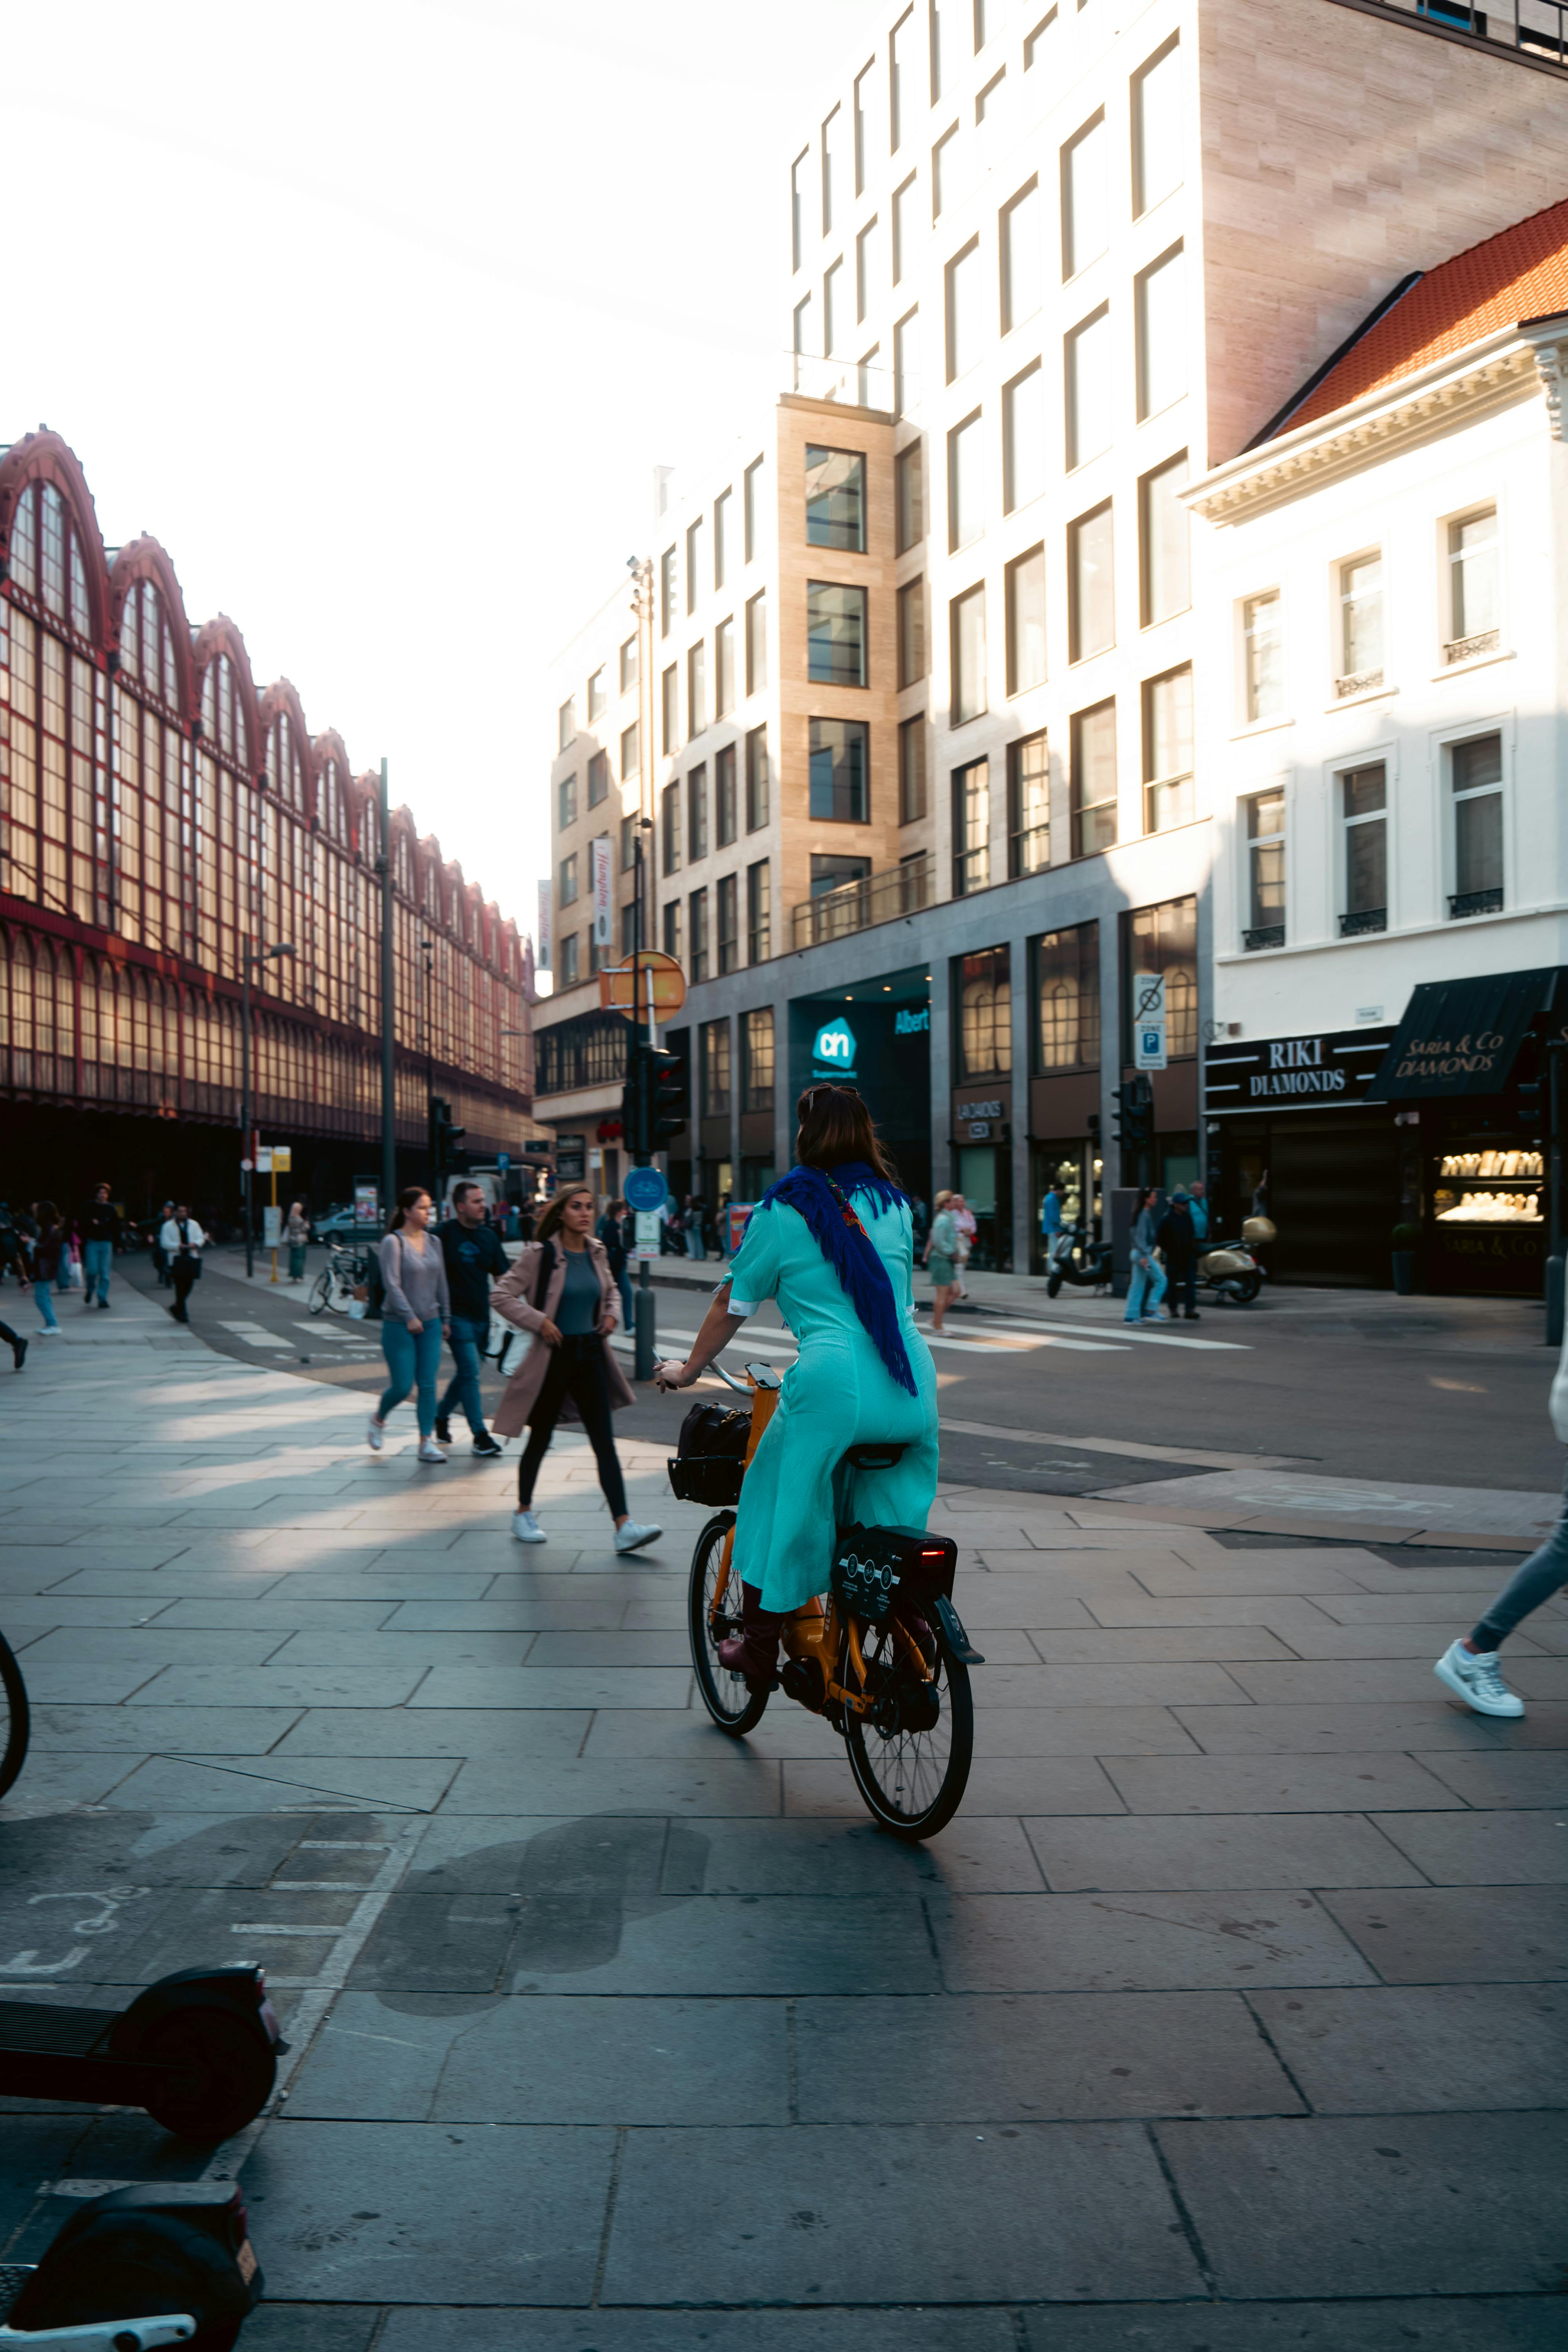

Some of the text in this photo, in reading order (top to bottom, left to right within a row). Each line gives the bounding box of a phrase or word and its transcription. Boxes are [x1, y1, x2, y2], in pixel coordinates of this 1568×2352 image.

[895, 1008, 929, 1035] Albert
[1147, 1035, 1156, 1047] P
[1269, 1038, 1323, 1069] RIKI
[1396, 1054, 1496, 1078] DIAMONDS
[1249, 1068, 1346, 1096] DIAMONDS
